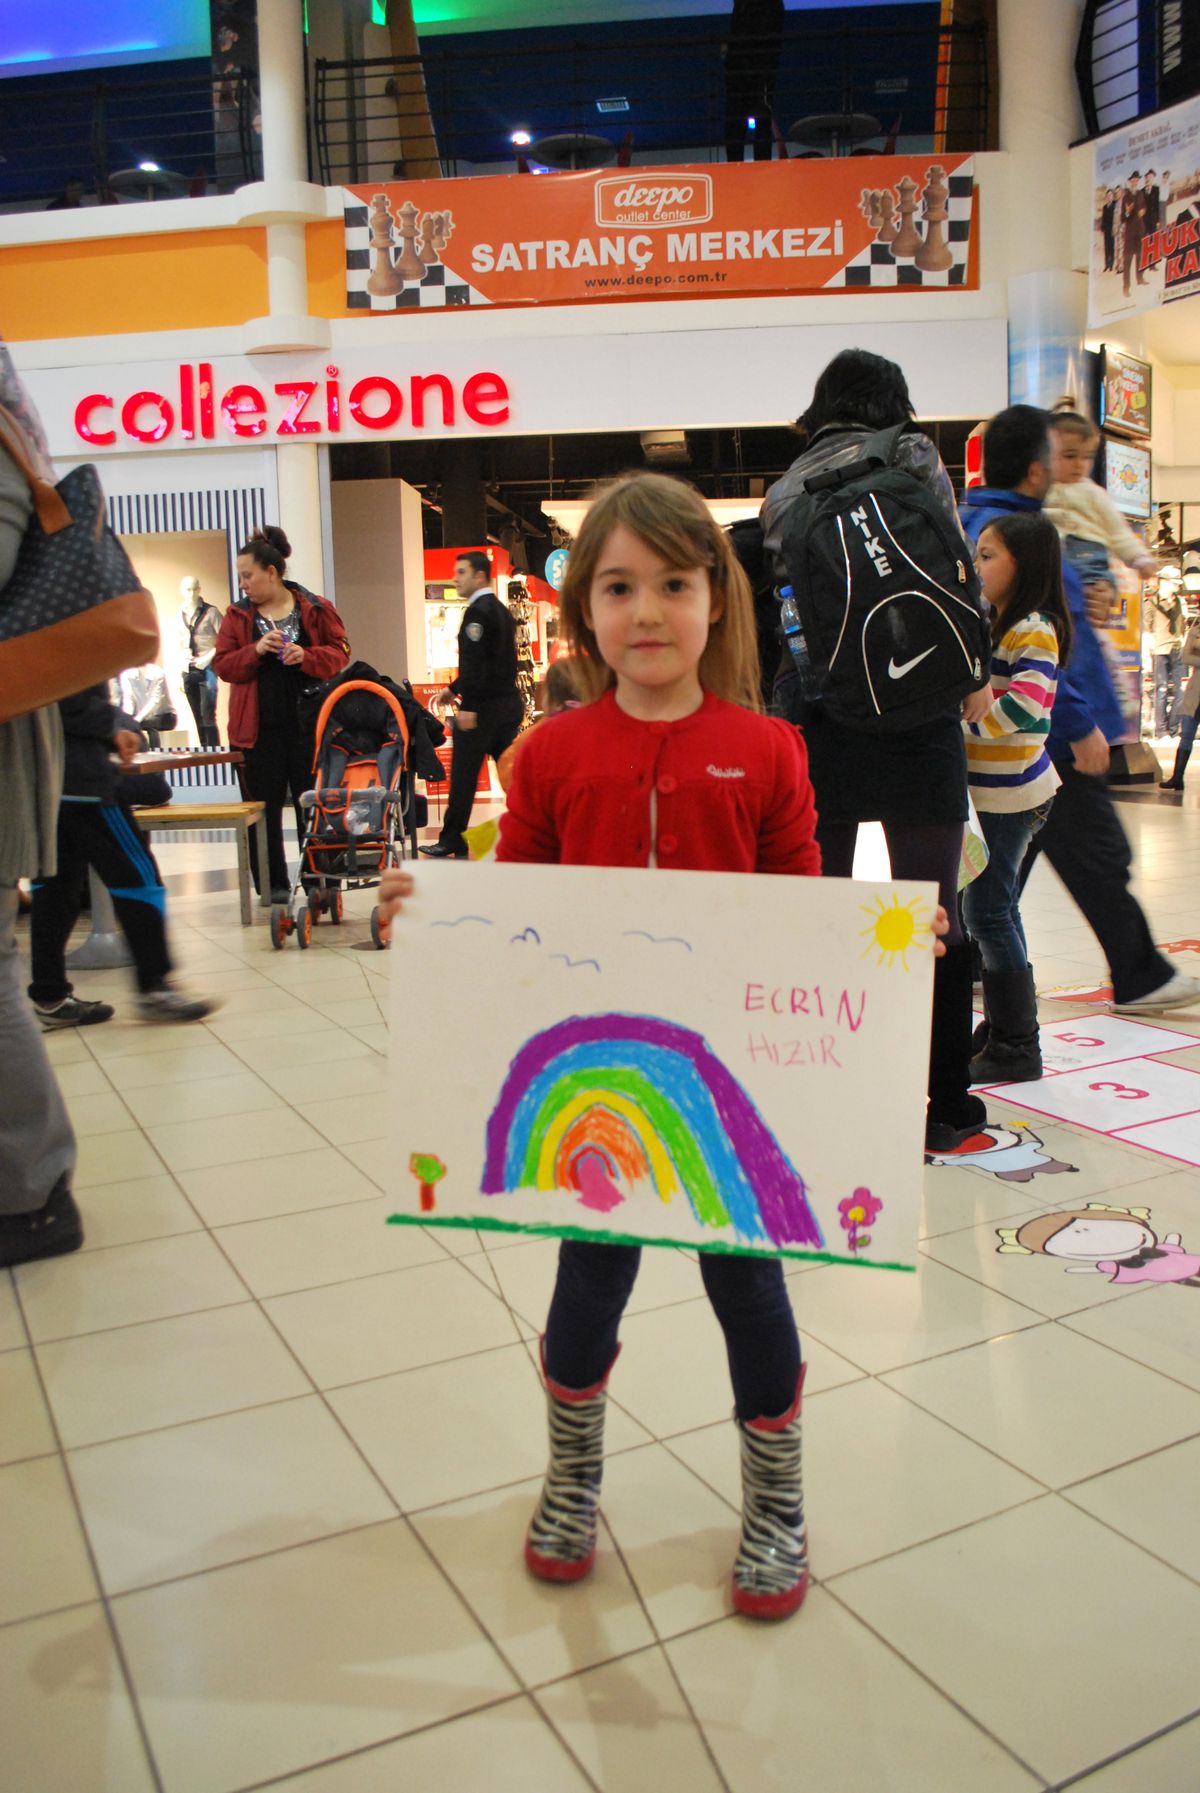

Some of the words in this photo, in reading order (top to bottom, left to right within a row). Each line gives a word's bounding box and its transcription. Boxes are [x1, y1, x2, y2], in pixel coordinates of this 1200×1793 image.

[614, 184, 694, 214] deepo
[616, 211, 649, 222] outlet
[653, 209, 691, 221] center
[471, 235, 654, 273] SATRANÇ
[666, 219, 844, 263] MERKEZİ
[585, 271, 728, 288] www.deepo.com.tr
[74, 363, 510, 446] collezione
[849, 504, 893, 578] NIKE
[747, 1031, 843, 1069] HIZIR
[1051, 1032, 1105, 1047] 5
[1087, 1081, 1150, 1099] 3
